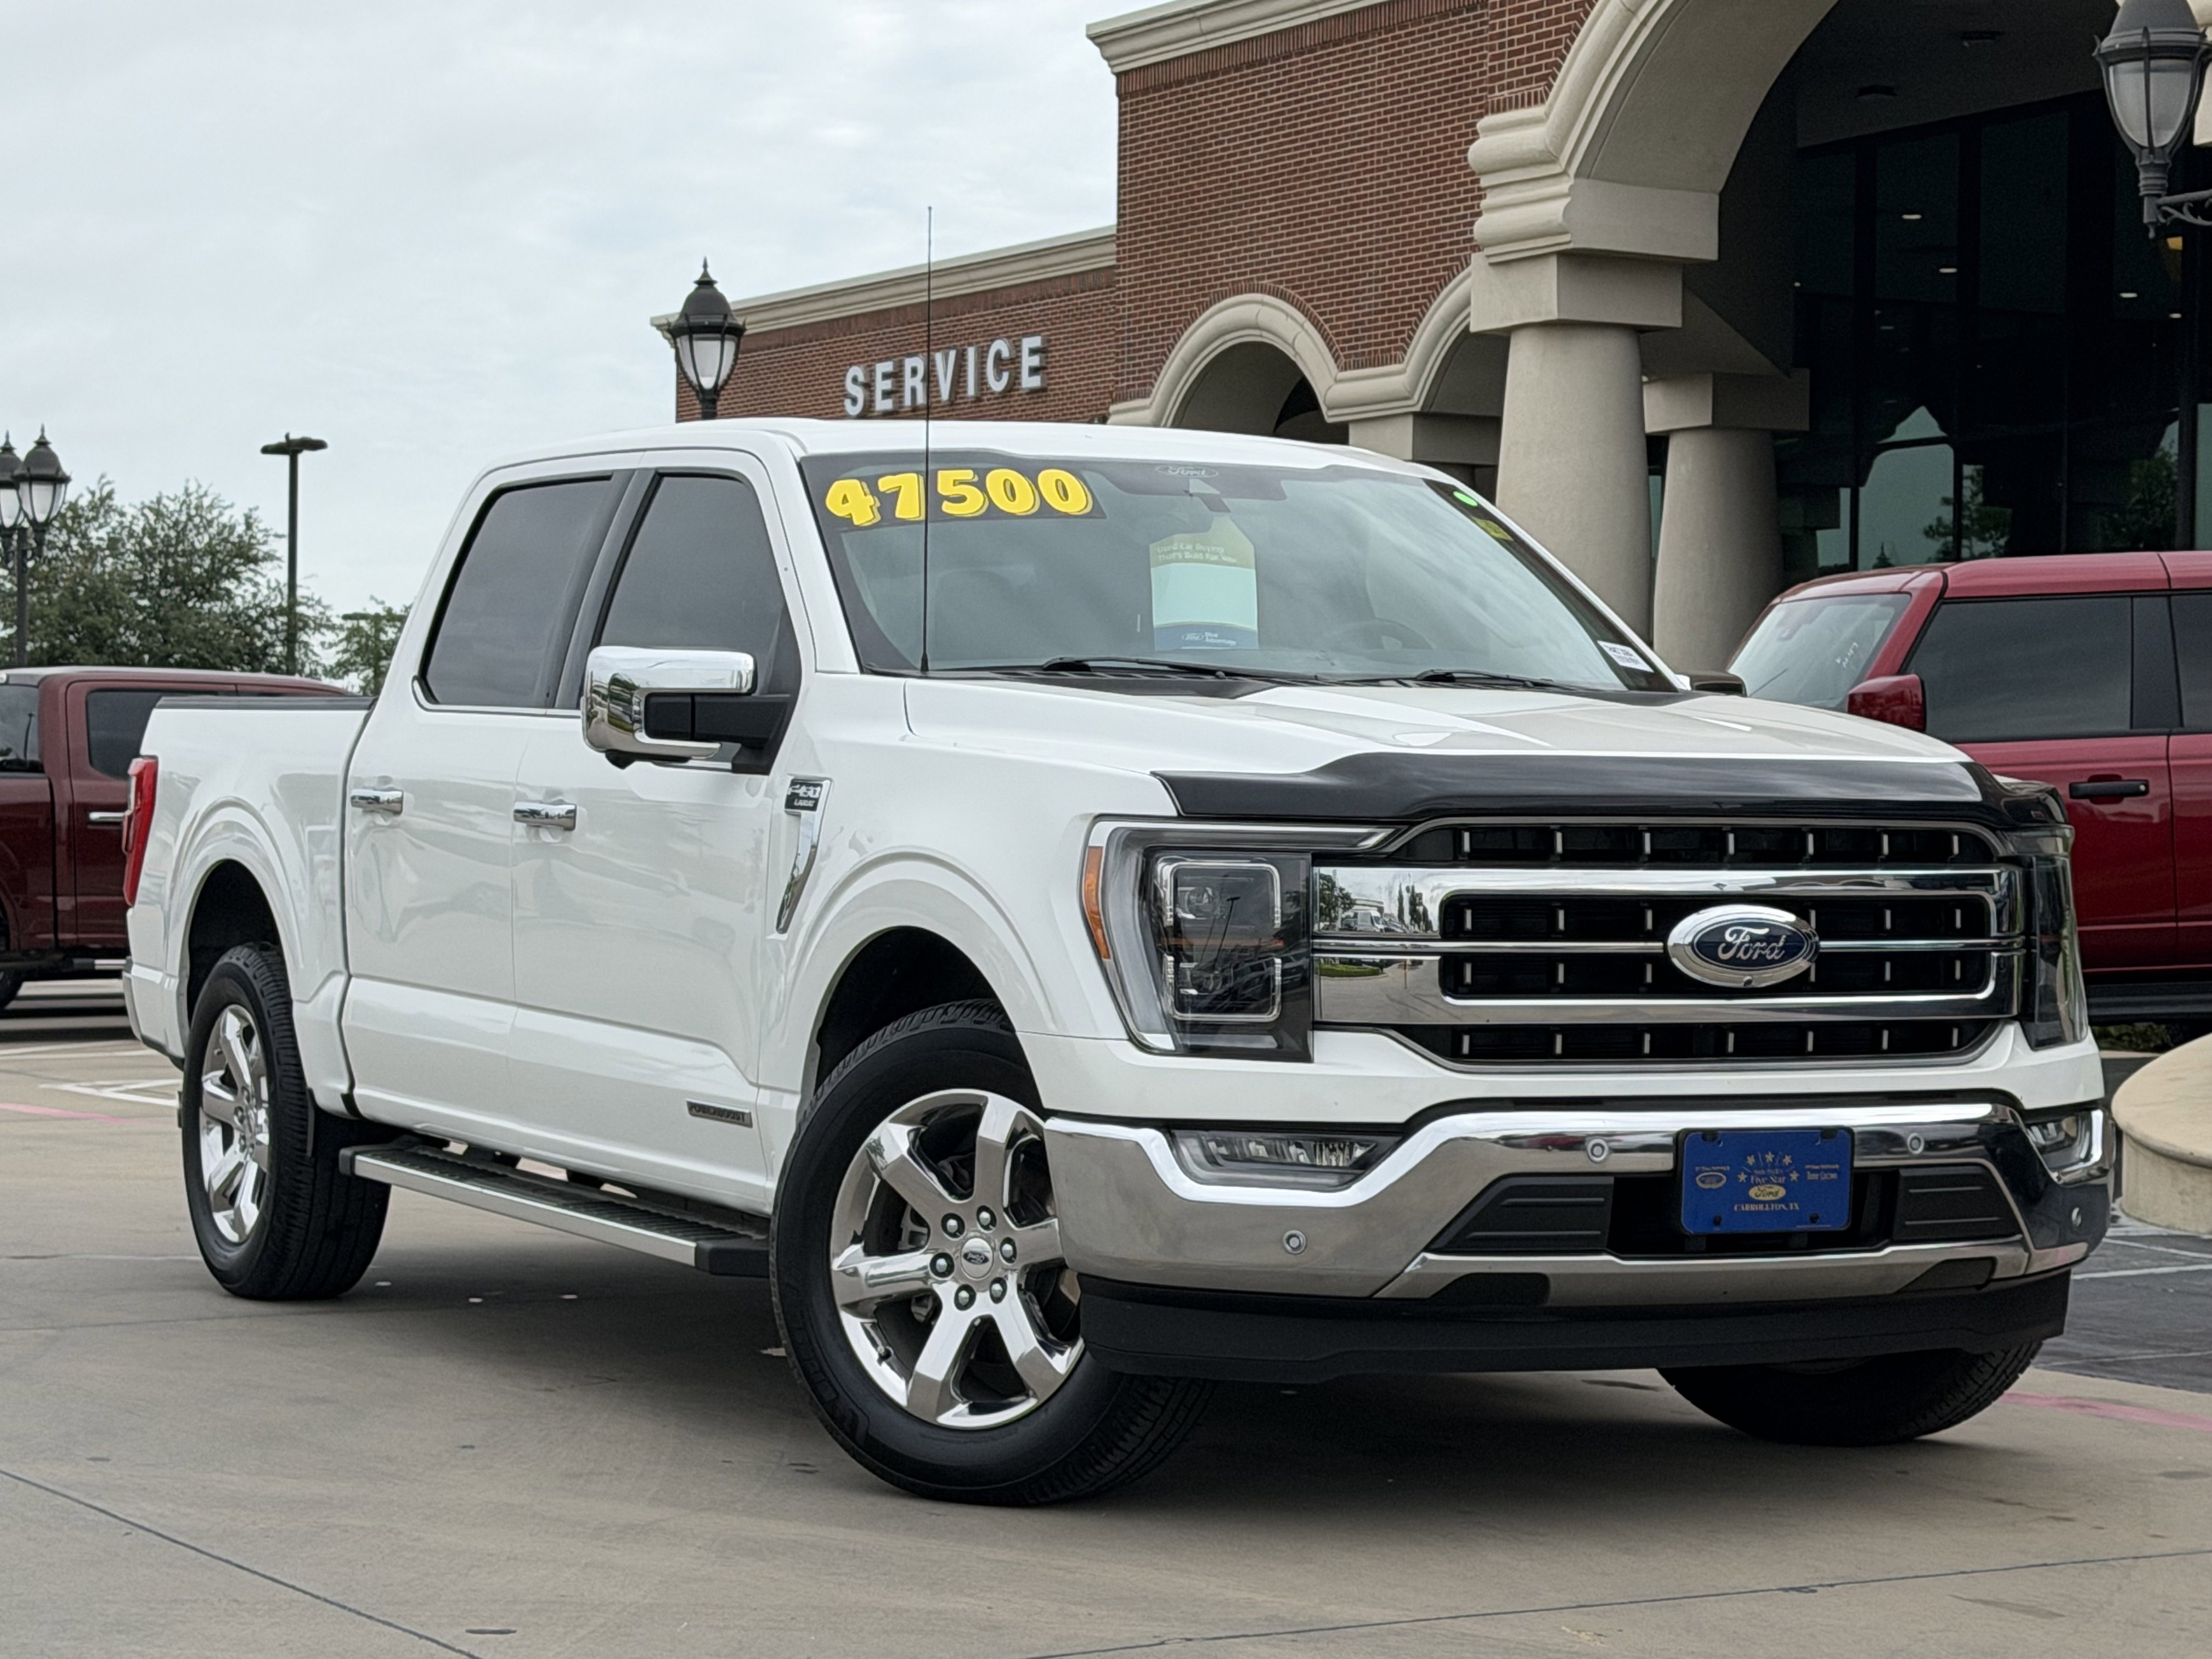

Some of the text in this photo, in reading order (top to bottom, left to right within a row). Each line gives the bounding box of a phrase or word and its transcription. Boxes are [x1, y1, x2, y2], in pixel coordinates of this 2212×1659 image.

[843, 334, 1046, 417] SERVICE
[825, 468, 1093, 526] 47500
[1718, 926, 1786, 960] Ford
